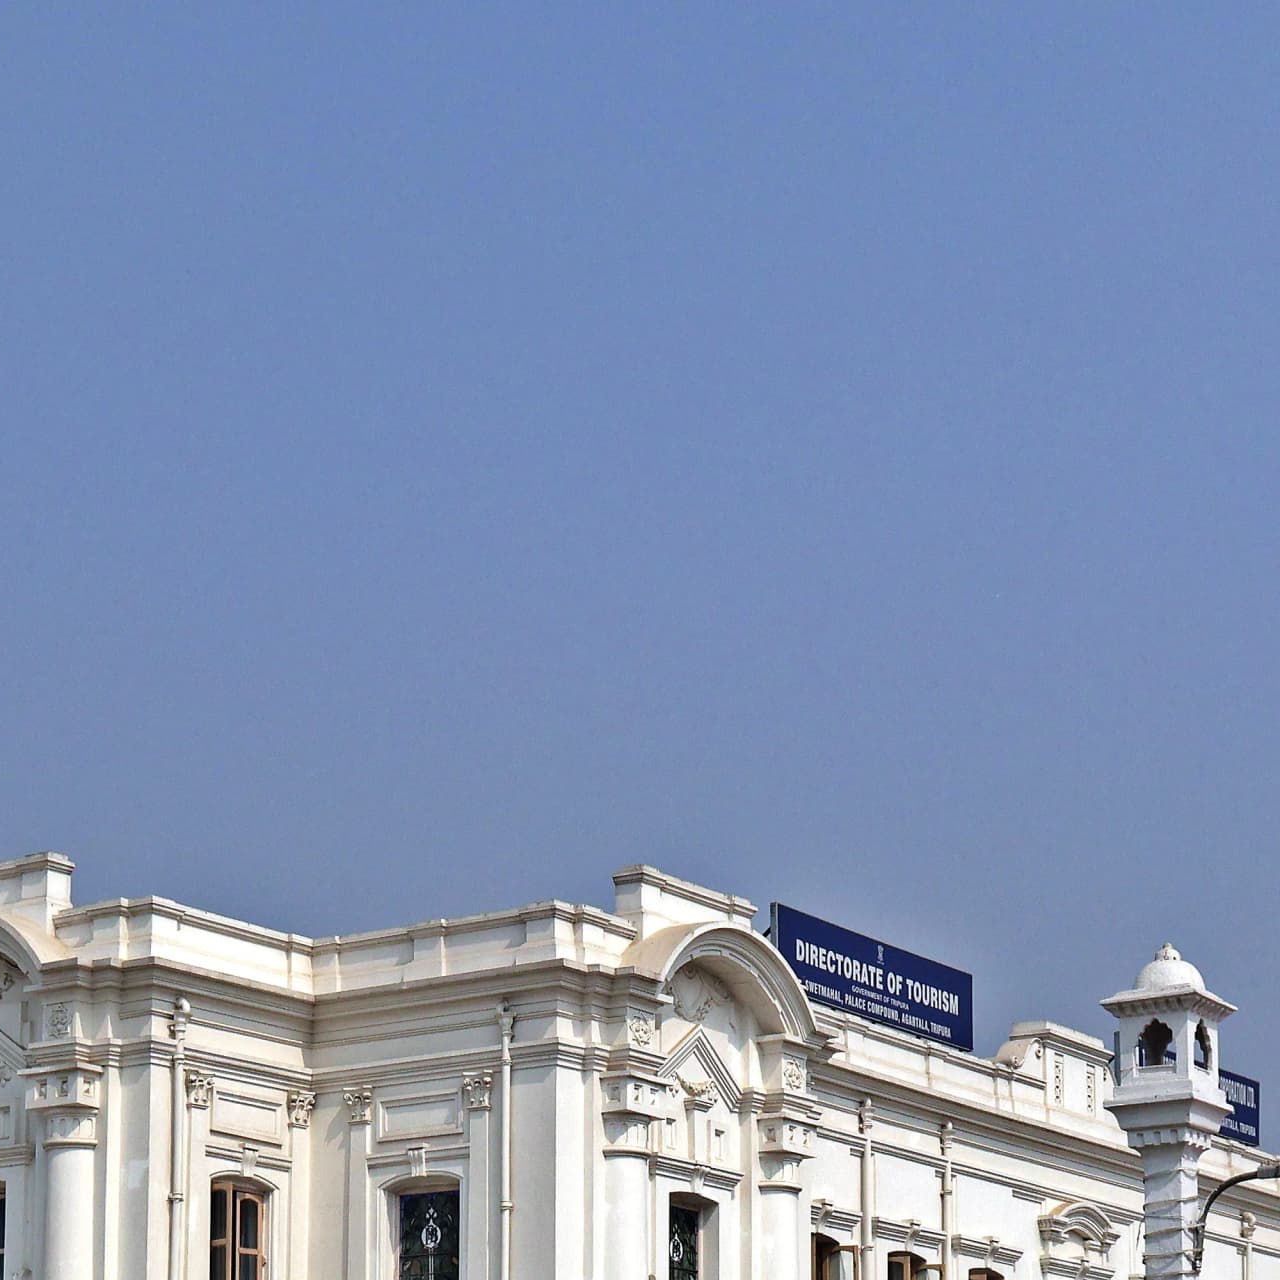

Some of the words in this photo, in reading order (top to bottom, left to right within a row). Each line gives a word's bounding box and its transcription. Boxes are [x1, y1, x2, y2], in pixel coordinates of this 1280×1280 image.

[795, 938, 884, 990] DIRECTORATE
[887, 972, 903, 996] OF
[906, 978, 959, 1016] TOURISM
[851, 984, 882, 1002] GOVERNMENT
[883, 995, 890, 1003] OF
[890, 997, 910, 1011] TRIPURA
[805, 979, 844, 1005] SWETMAHAL,
[844, 994, 866, 1011] PALACE
[867, 1000, 900, 1022] COMPOUND,
[901, 1014, 930, 1032] AGARTALA,
[930, 1021, 951, 1038] TRIPURA
